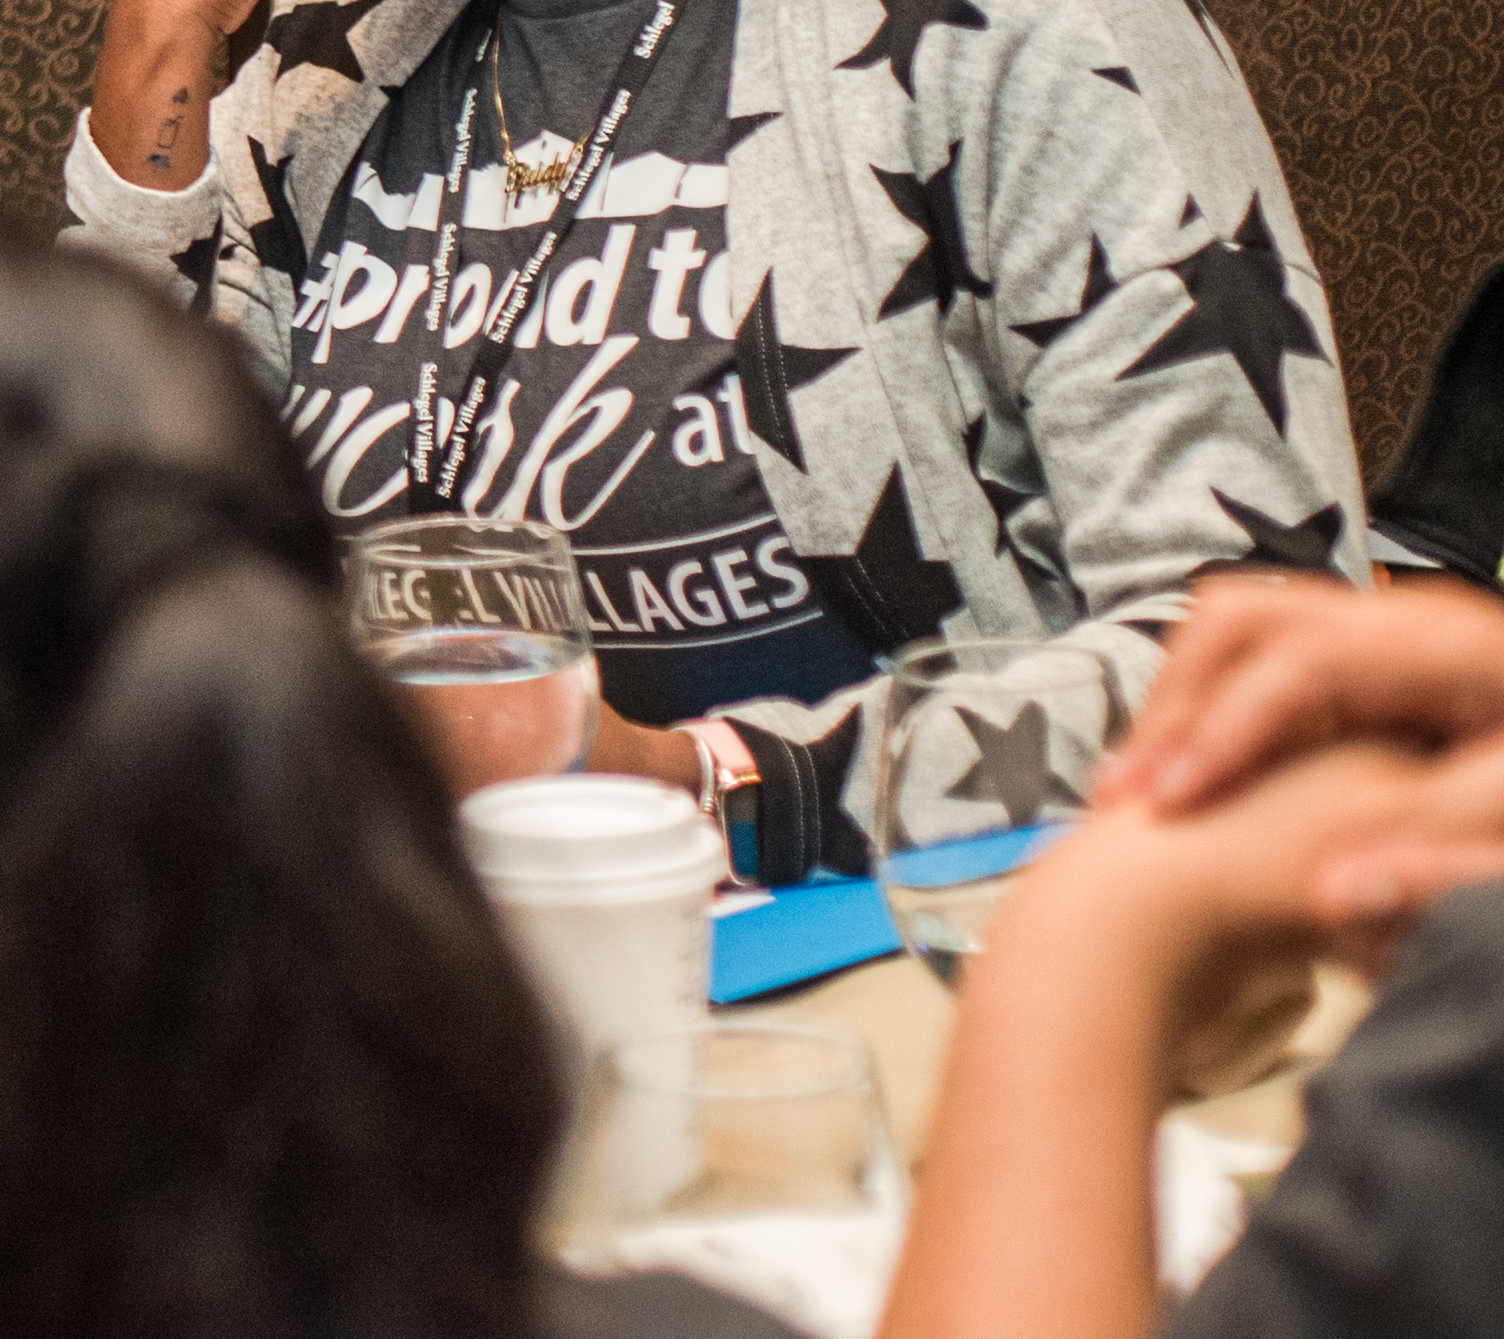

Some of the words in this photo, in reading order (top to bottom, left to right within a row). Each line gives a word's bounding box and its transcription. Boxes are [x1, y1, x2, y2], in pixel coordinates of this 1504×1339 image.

[634, 0, 675, 59] Schlegel
[455, 87, 478, 139] Schlegel
[448, 139, 471, 194] Villages
[564, 142, 604, 201] Schlegel
[593, 88, 632, 143] Villages
[432, 222, 457, 277] Schlegel
[291, 224, 637, 364] #proud
[425, 277, 450, 332] Villages
[488, 282, 528, 343] Schlegel
[519, 230, 558, 283] Villages
[415, 362, 438, 421] Schlegel
[671, 374, 759, 467] at
[410, 421, 434, 483] Villages
[435, 429, 469, 499] Schlegel
[455, 376, 487, 435] Villages
